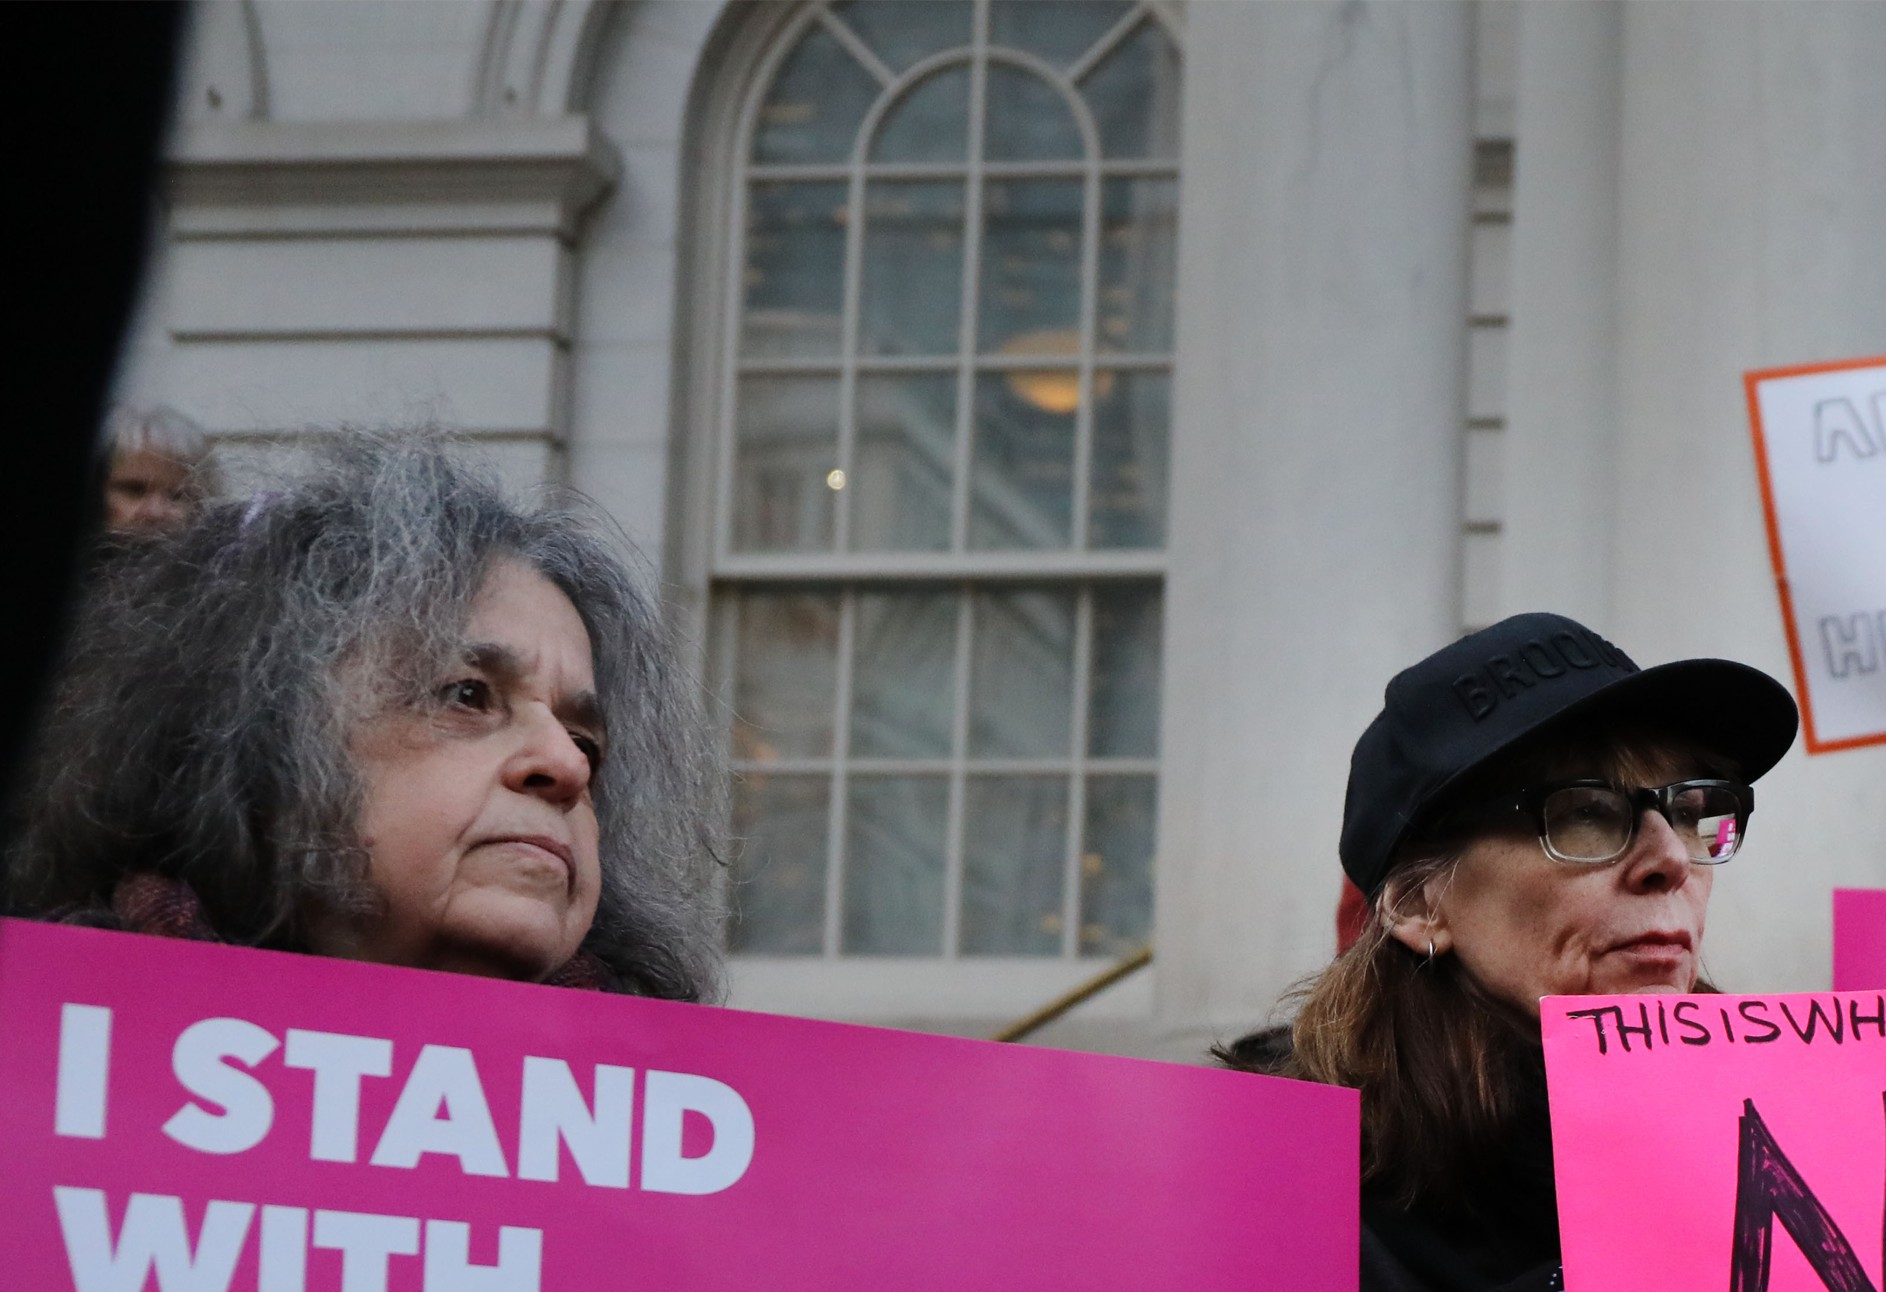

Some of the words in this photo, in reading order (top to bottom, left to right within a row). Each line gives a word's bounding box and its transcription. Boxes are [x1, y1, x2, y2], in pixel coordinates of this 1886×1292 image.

[1452, 629, 1640, 723] BROO
[54, 1002, 113, 1140] I
[161, 1017, 756, 1195] STAND
